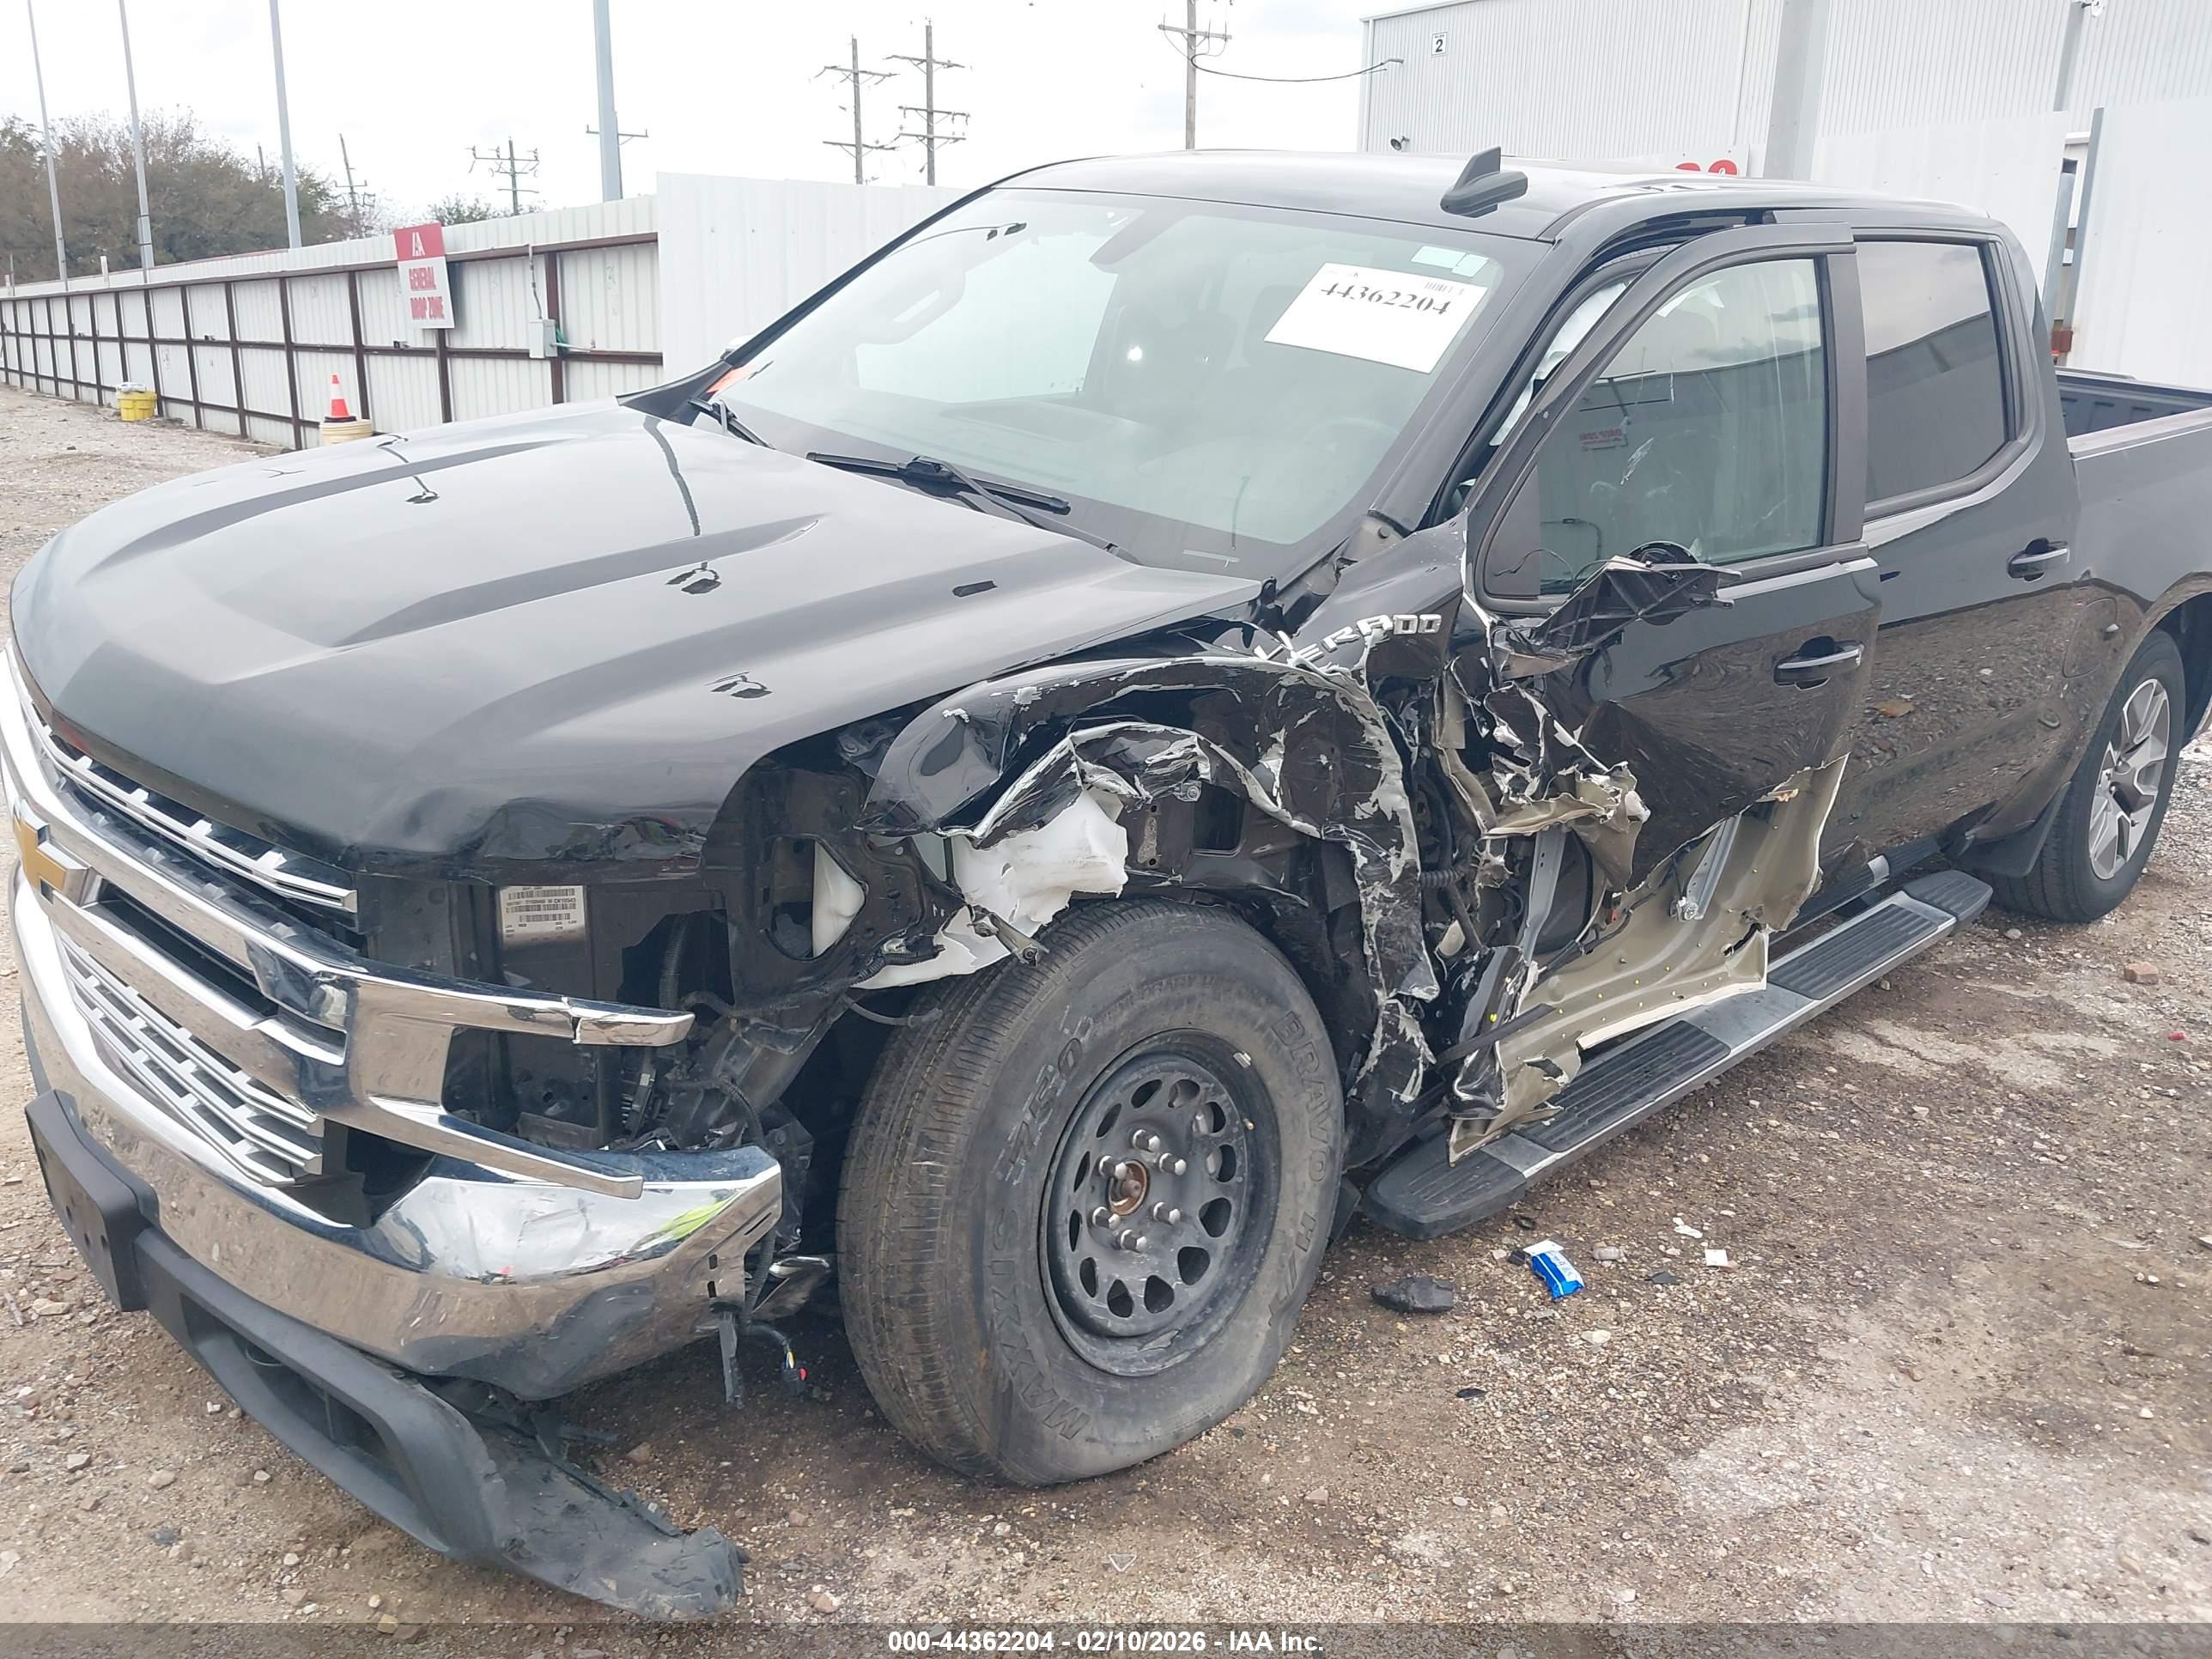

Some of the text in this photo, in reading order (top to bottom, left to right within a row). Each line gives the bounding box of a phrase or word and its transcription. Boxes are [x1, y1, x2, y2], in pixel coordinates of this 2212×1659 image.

[1435, 39, 1443, 52] 2
[410, 267, 436, 291] GENERAL
[410, 295, 445, 320] DROP ZONE
[1321, 282, 1452, 315] 44362204
[1271, 1010, 1328, 1183] BRAVO
[989, 1206, 1092, 1441] MAXXIS
